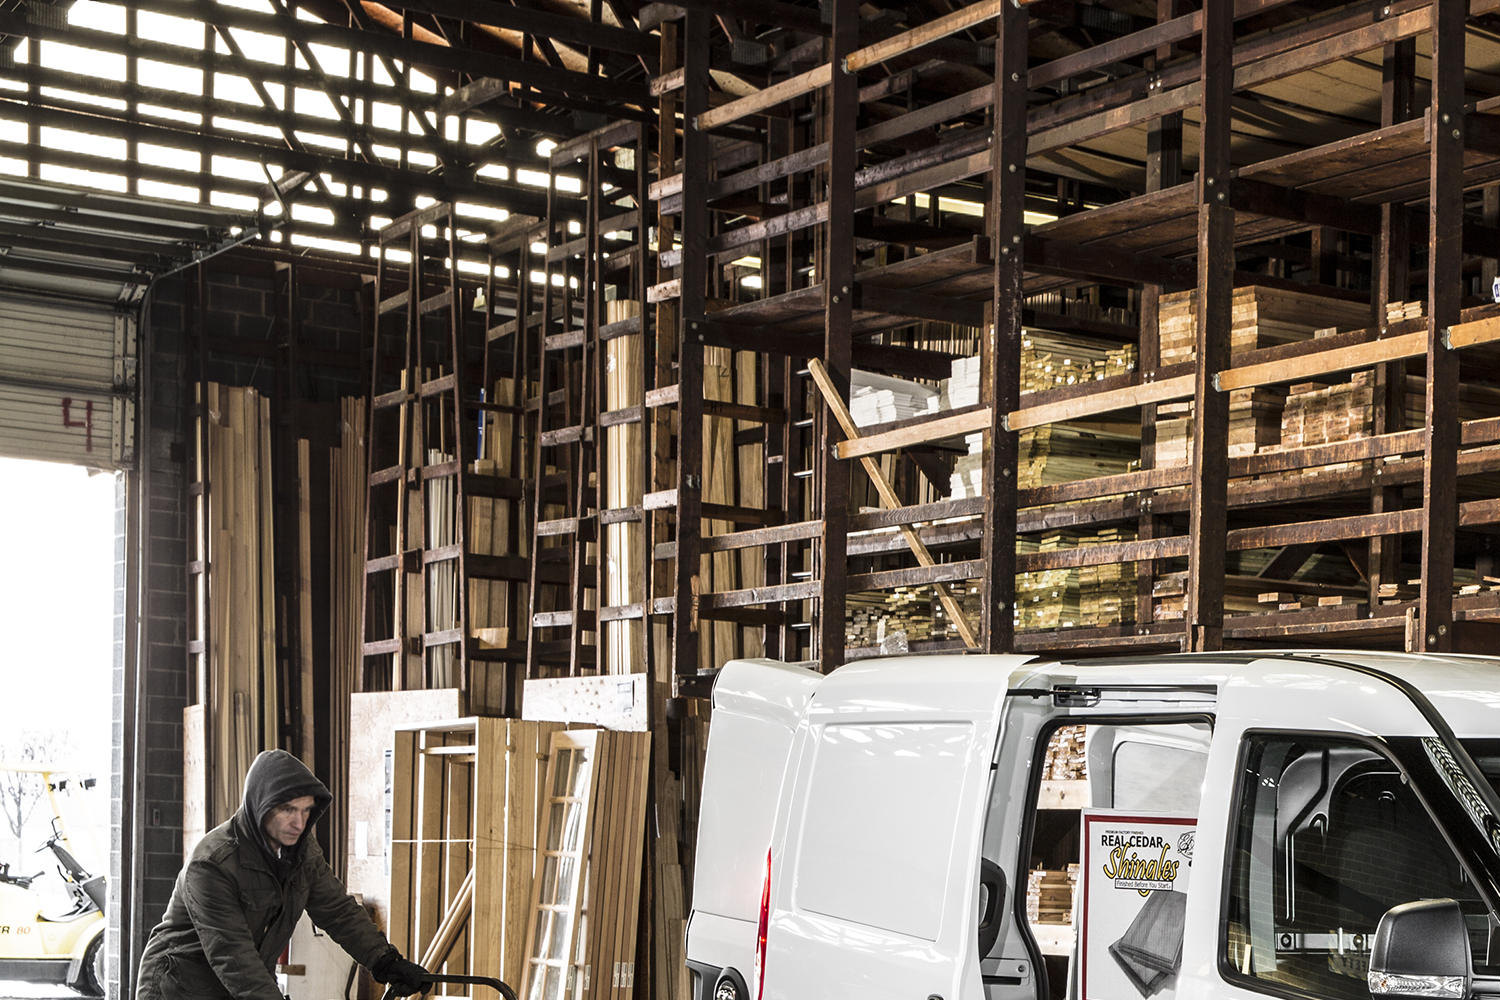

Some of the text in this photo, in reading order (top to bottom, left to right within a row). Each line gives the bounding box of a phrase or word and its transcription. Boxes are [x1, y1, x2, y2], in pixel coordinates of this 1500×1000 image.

[62, 397, 93, 453] 4
[1101, 835, 1126, 847] REAL
[1129, 836, 1164, 848] CEDAR
[1103, 842, 1180, 897] Shingles
[1116, 880, 1134, 888] Finished
[16, 926, 31, 935] 80
